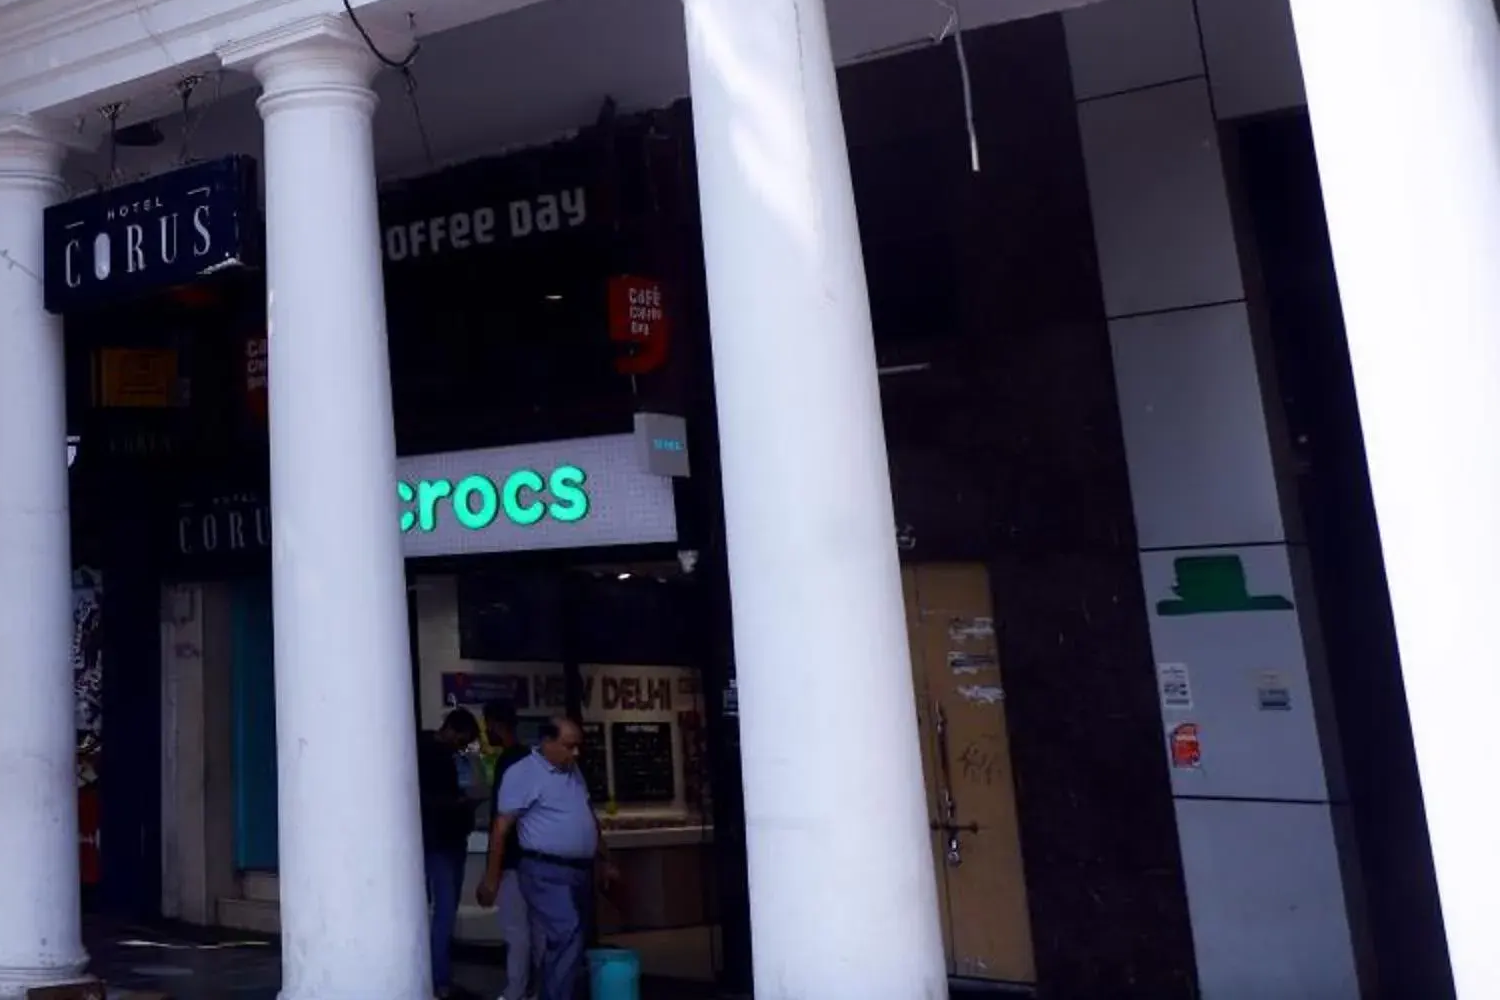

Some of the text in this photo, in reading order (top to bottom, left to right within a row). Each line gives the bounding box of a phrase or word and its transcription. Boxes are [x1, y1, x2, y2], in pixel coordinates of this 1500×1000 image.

[106, 196, 164, 221] HOTEL
[508, 186, 587, 238] Day
[65, 204, 212, 289] CORUS
[601, 675, 673, 712] DELHI
